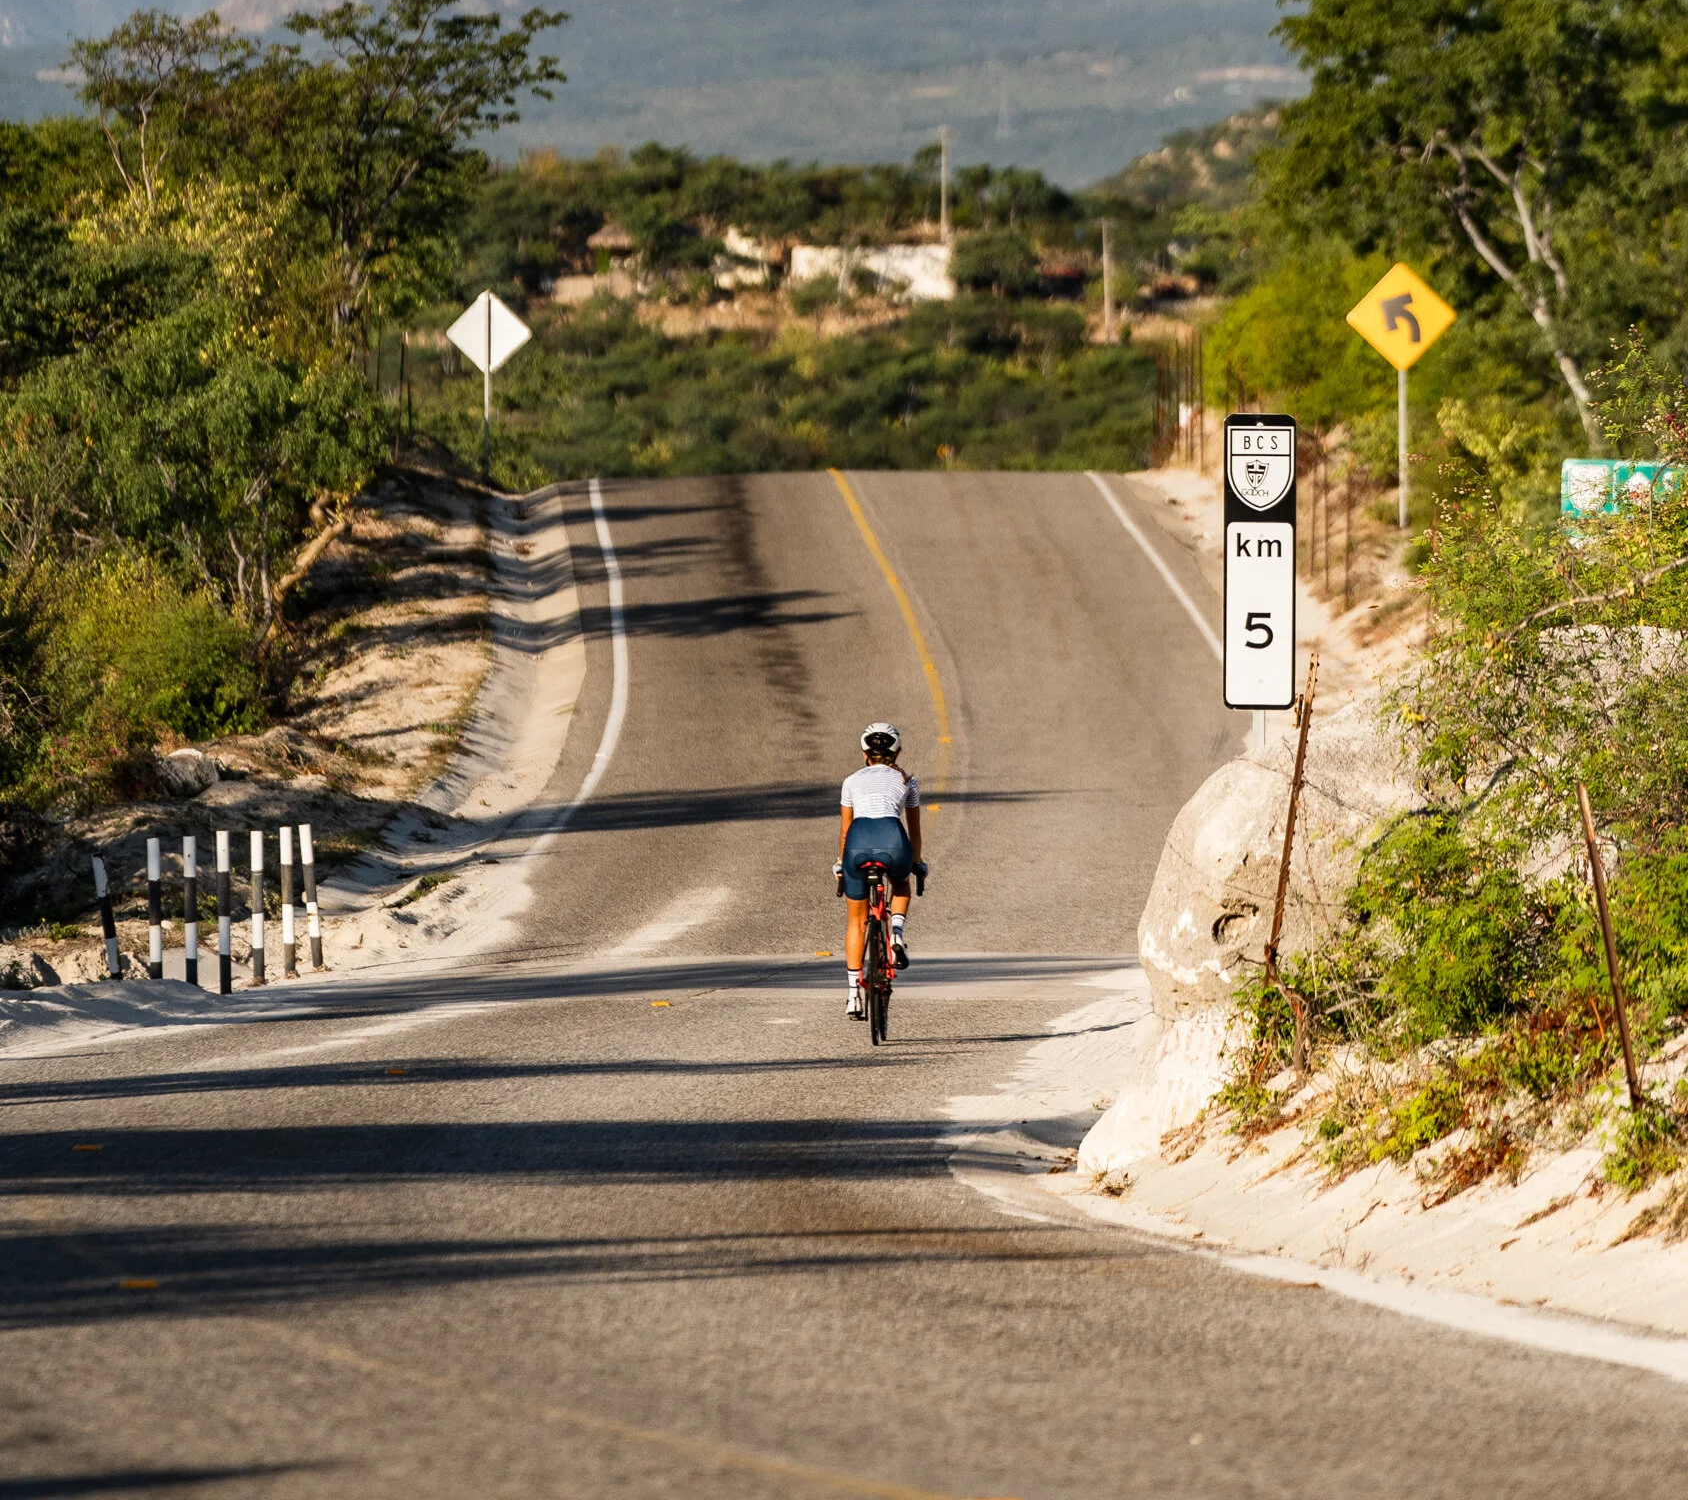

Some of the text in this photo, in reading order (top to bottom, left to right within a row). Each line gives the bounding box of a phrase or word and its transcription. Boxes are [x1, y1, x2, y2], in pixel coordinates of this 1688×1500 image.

[1243, 435, 1278, 450] BCS
[1236, 532, 1282, 558] km
[1244, 612, 1274, 650] 5
